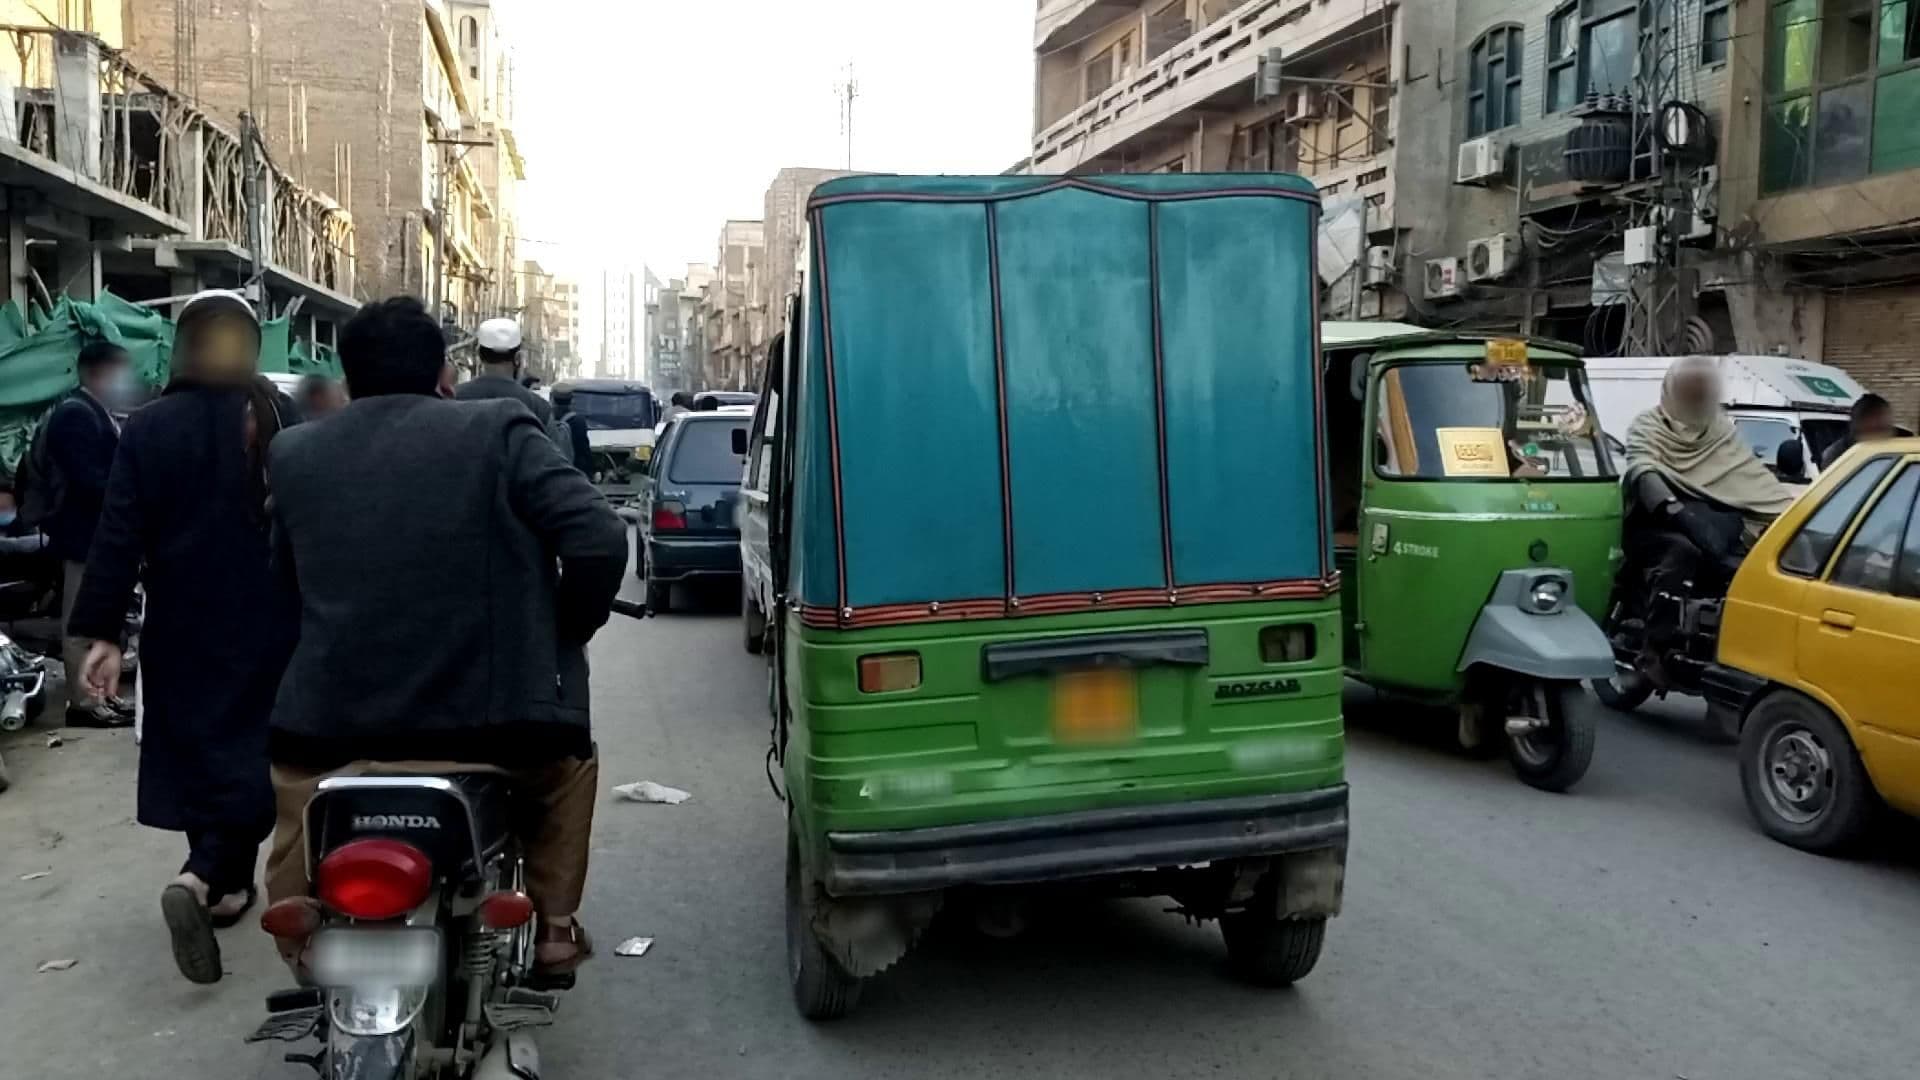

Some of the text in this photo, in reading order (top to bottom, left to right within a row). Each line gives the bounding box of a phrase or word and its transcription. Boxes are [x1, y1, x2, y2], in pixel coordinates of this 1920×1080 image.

[1393, 541, 1439, 558] 4 STROKE
[353, 815, 440, 830] HONDA
